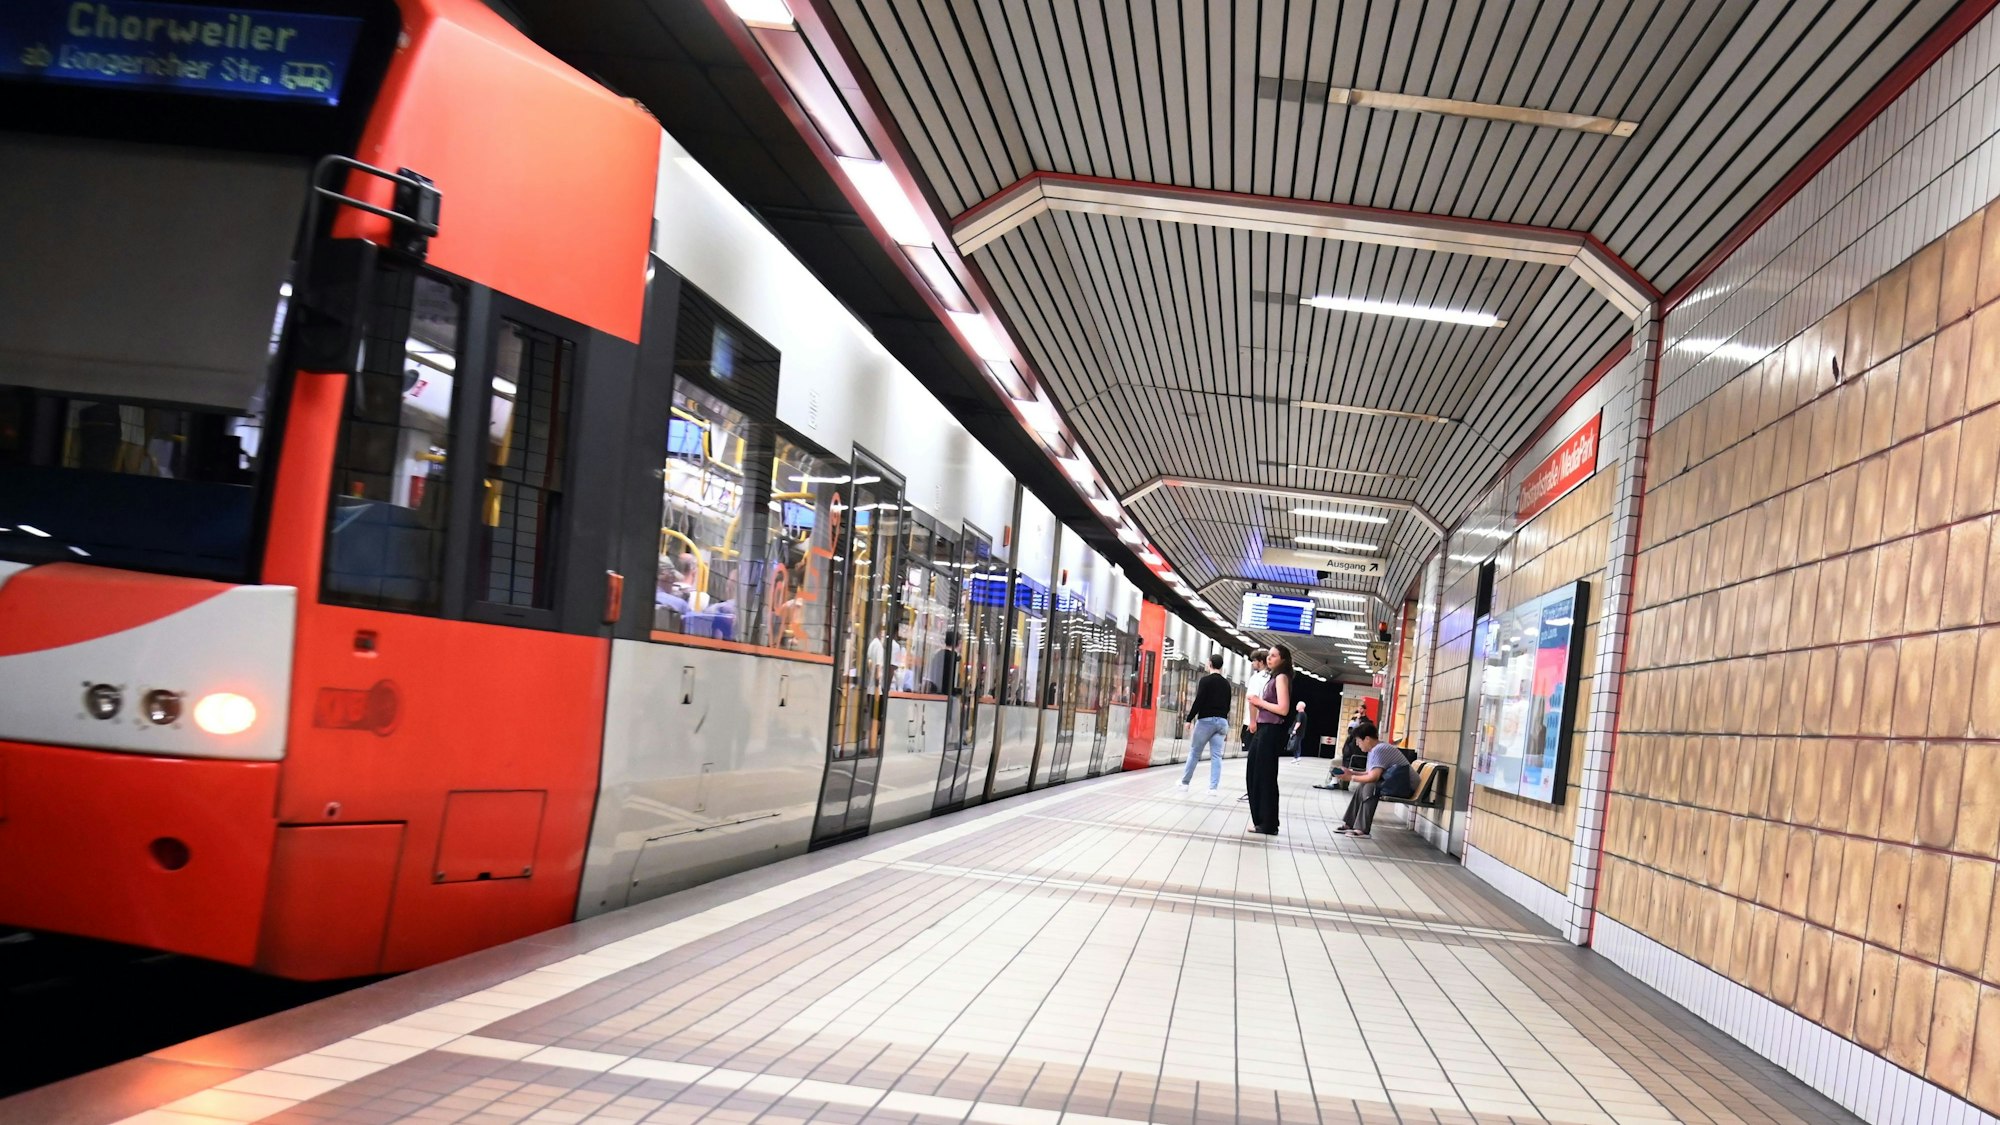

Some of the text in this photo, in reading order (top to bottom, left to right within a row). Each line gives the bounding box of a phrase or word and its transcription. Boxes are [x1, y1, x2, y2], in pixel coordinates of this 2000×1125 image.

[67, 2, 297, 53] Chorweiler
[21, 44, 51, 67] ab
[220, 56, 271, 86] Str.
[1327, 559, 1366, 572] Ausgang
